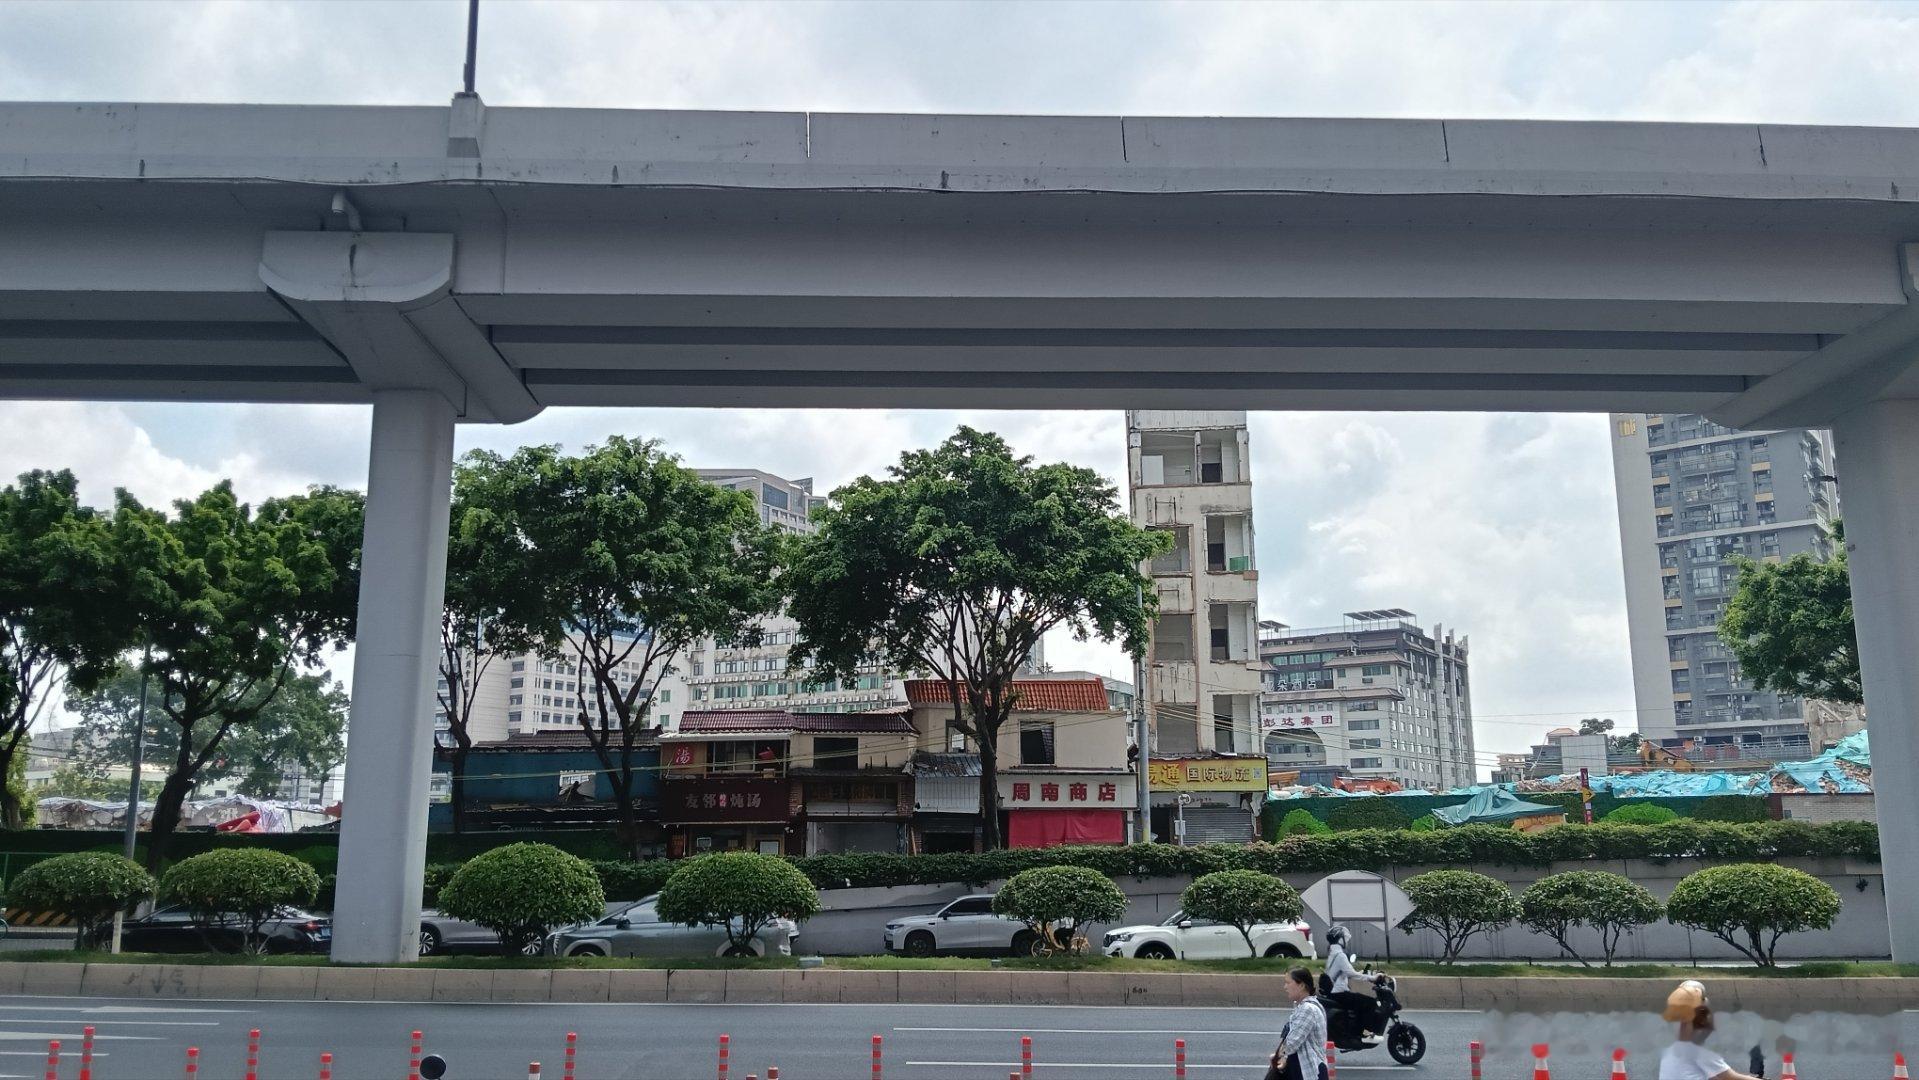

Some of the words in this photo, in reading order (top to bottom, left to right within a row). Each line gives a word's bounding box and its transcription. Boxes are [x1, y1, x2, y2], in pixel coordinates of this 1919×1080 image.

[1263, 715, 1333, 727] 彭达集团
[1012, 782, 1116, 802] 周南商店
